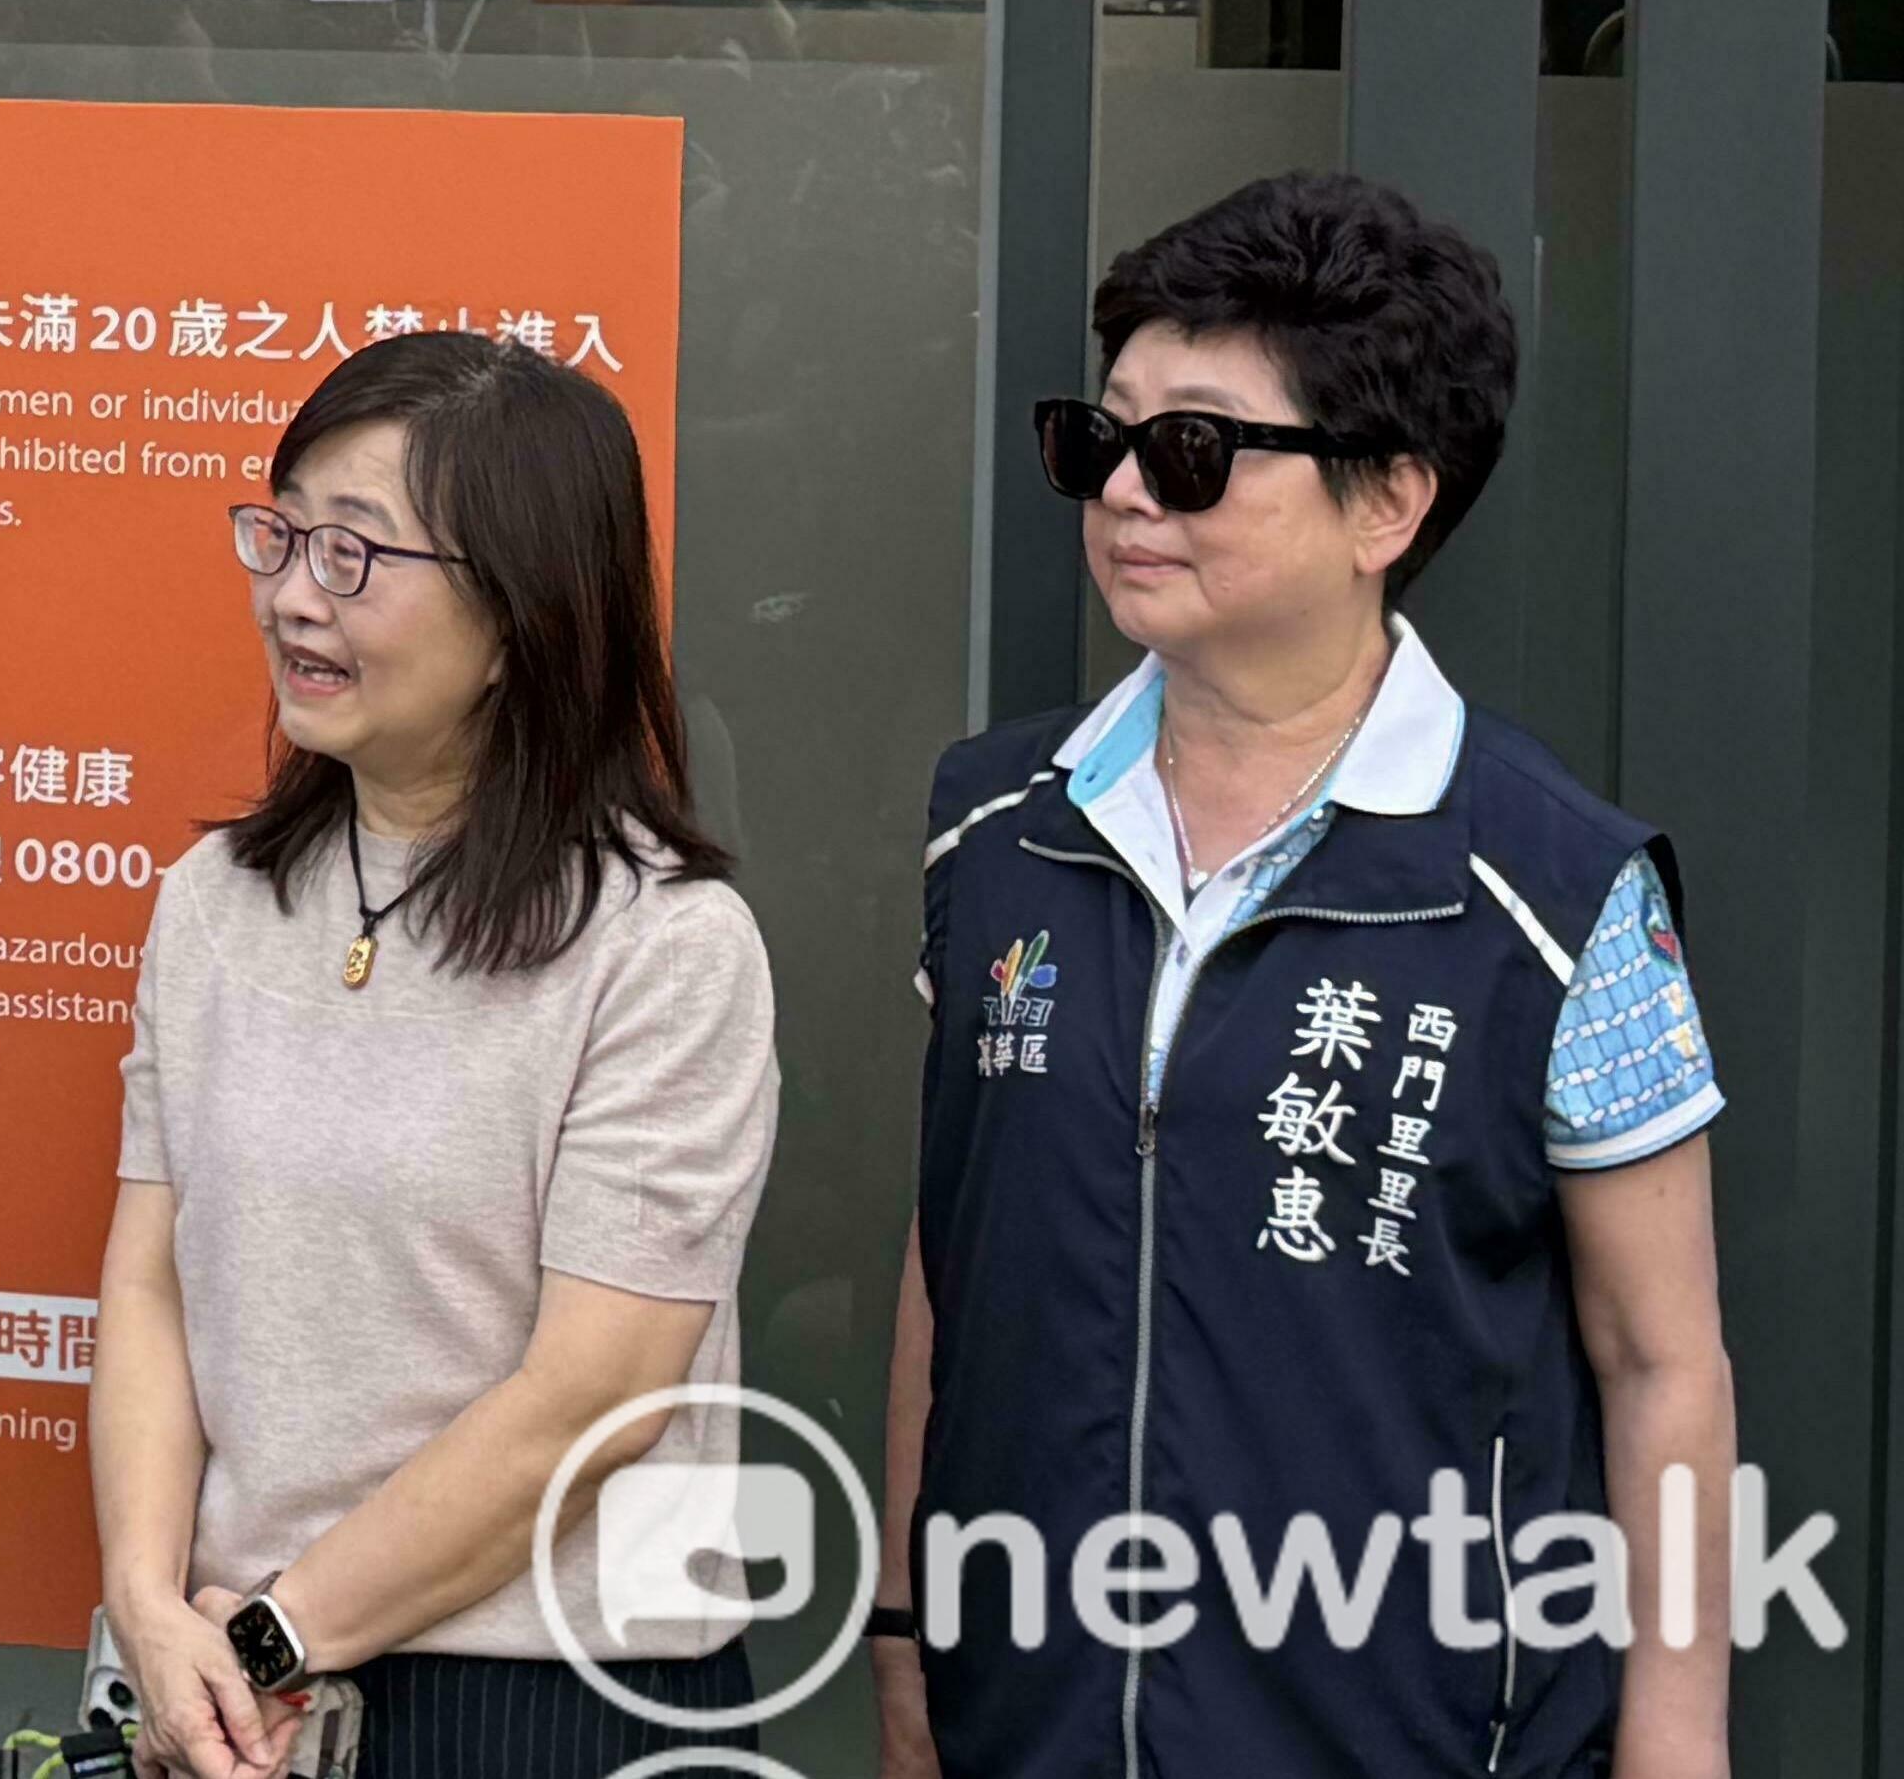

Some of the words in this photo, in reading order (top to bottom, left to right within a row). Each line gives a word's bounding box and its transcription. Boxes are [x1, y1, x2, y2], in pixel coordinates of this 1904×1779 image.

[90, 392, 128, 419] or
[140, 441, 226, 480] from
[1258, 978, 1381, 1263] 葉敏惠
[1357, 1003, 1457, 1276] 西門里里長
